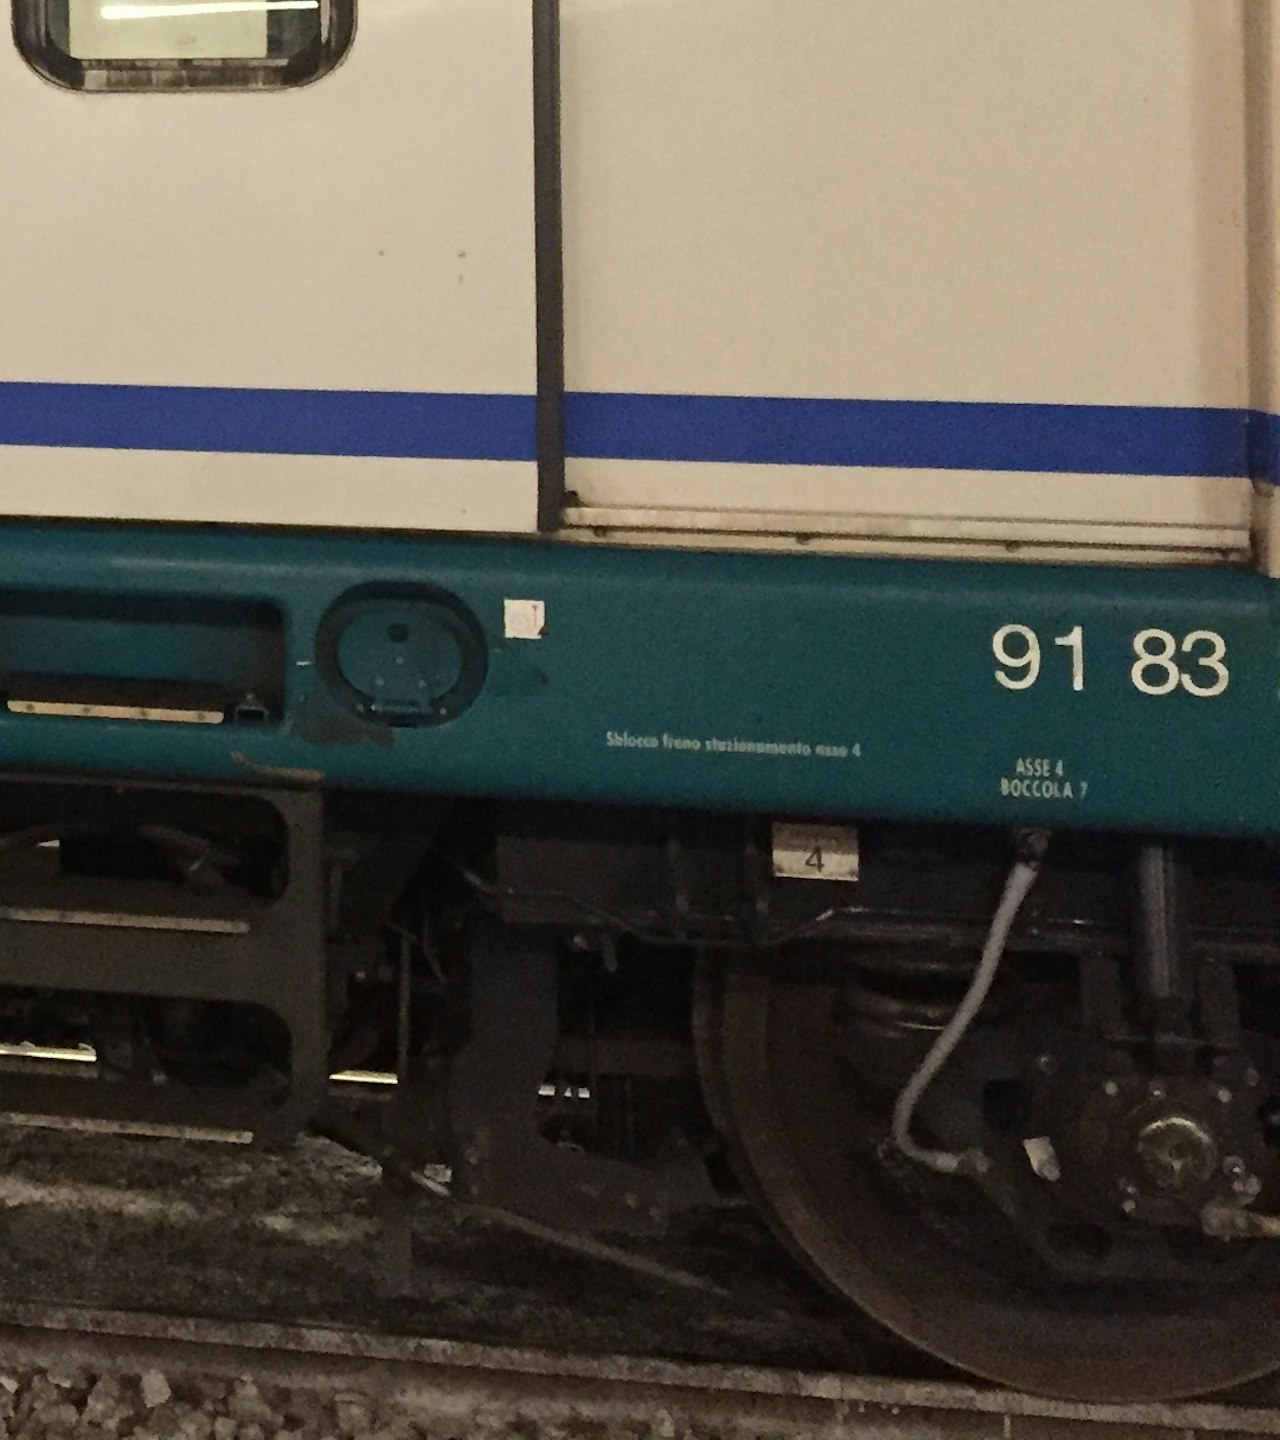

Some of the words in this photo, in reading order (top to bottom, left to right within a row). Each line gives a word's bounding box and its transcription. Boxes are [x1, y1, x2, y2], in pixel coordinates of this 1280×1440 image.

[993, 624, 1084, 691] 91
[1131, 628, 1230, 697] 83
[1016, 758, 1051, 777] ASSE
[1000, 777, 1073, 799] BOCCOLA
[805, 845, 824, 874] 4
